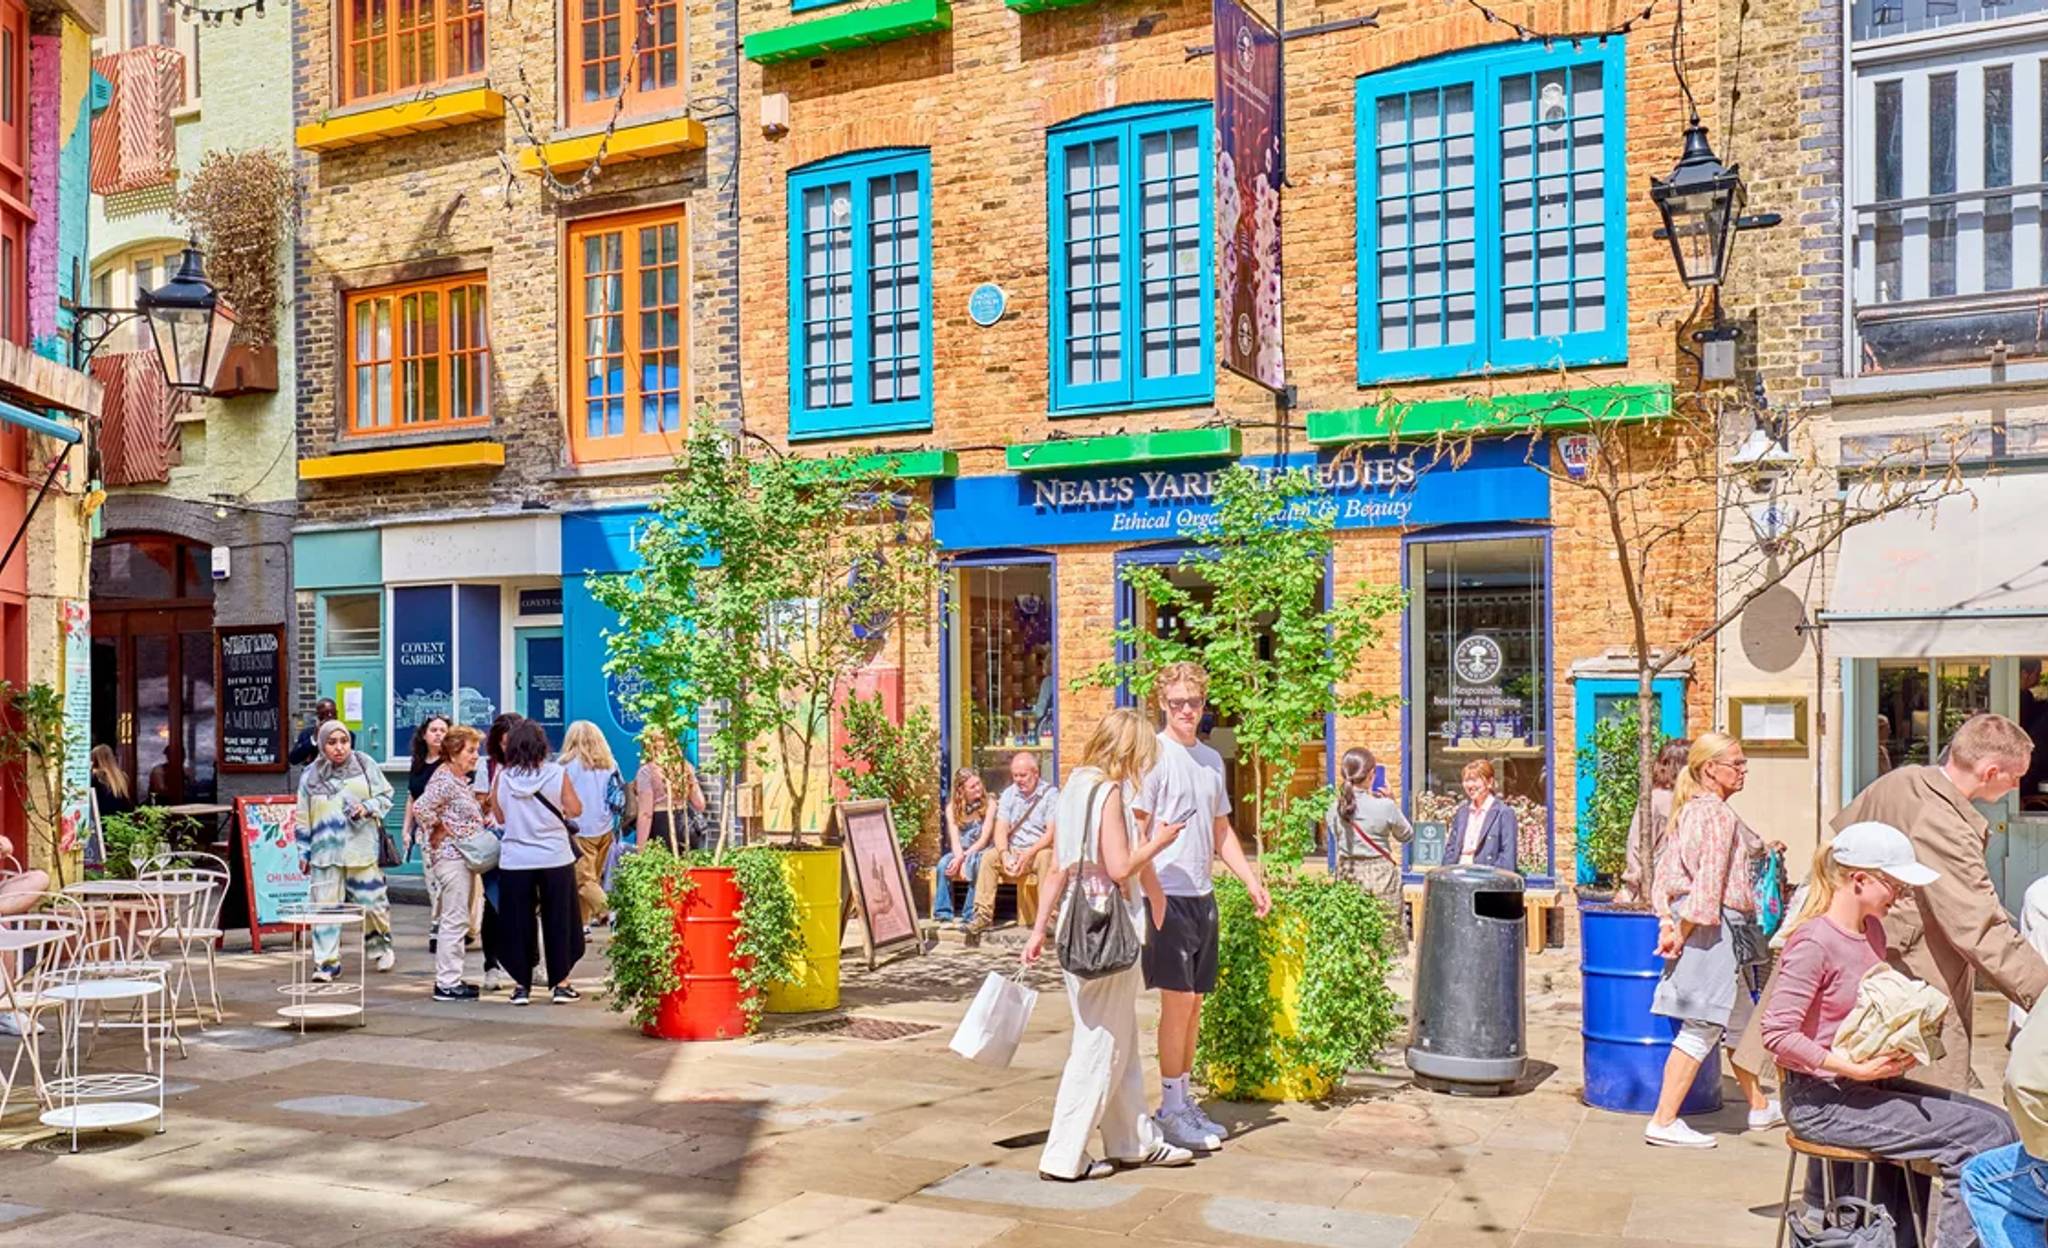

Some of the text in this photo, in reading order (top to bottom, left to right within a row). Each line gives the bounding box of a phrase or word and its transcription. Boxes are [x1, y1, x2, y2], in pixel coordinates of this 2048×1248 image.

[1111, 510, 1172, 532] Ethical
[1177, 508, 1235, 529] Orga
[1254, 499, 1312, 524] ealth
[1344, 499, 1413, 521] Beauty
[401, 641, 446, 654] COVENT
[401, 654, 446, 666] GARDEN
[233, 684, 270, 706] PIZZA?
